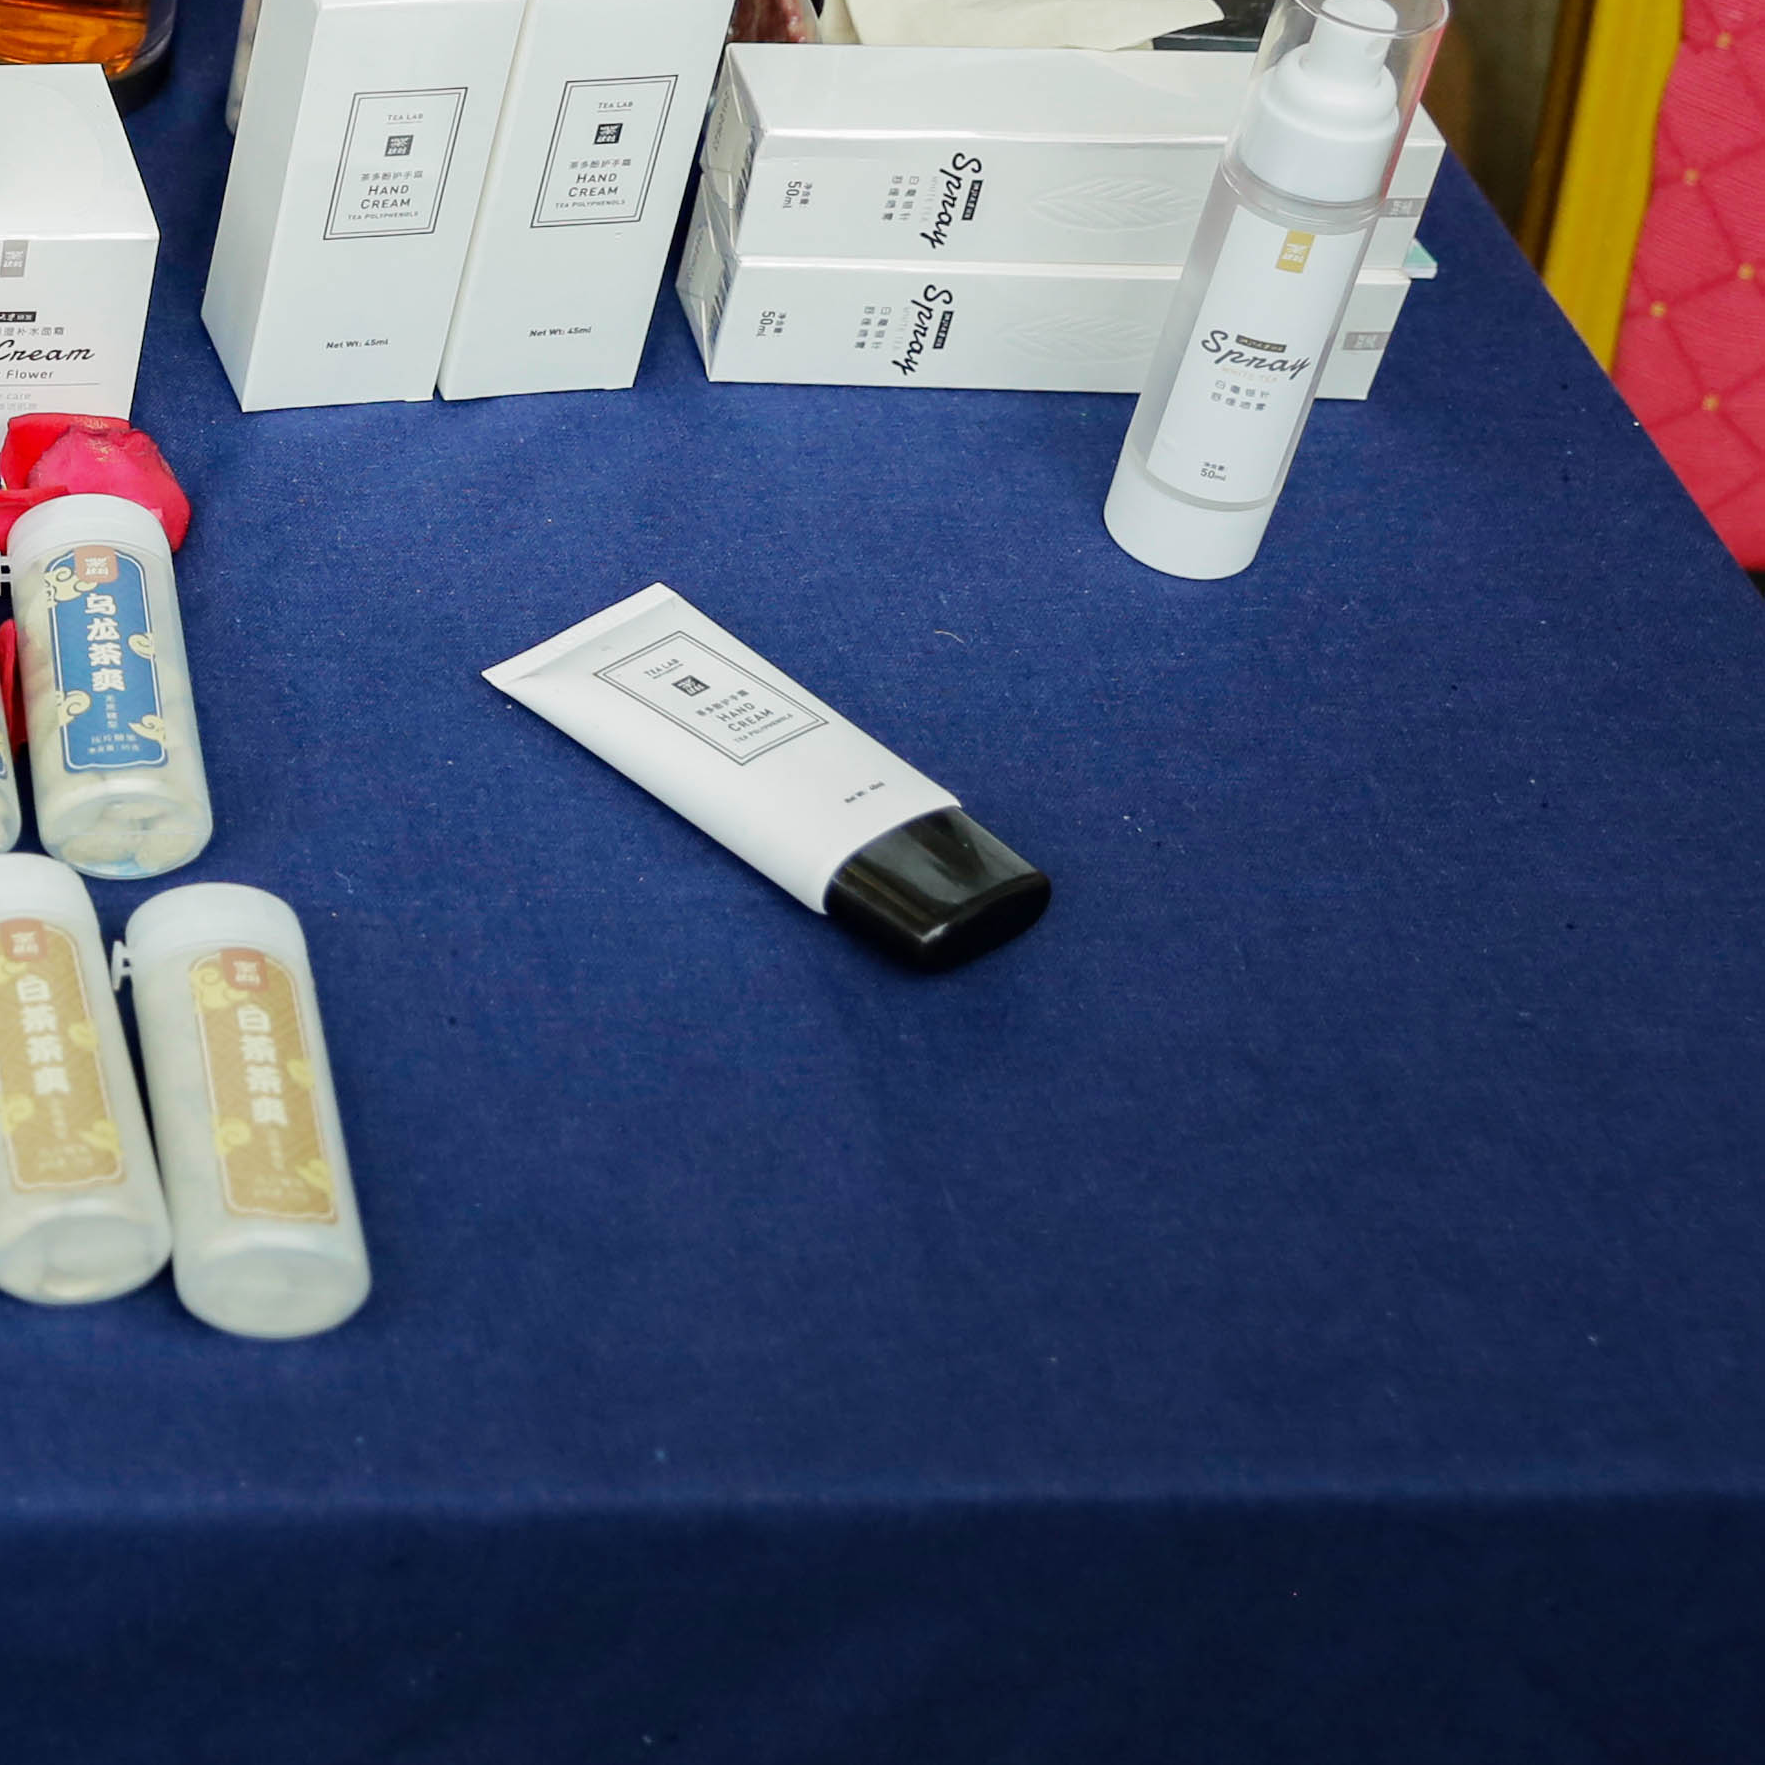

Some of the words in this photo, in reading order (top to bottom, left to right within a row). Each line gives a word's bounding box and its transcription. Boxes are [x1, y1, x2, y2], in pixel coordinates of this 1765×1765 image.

[576, 172, 617, 184] HAND
[368, 184, 409, 196] HAND
[568, 186, 618, 198] CREAM
[783, 180, 802, 209] 50ml
[919, 152, 983, 249] Spray
[361, 198, 410, 210] CREAM
[756, 310, 776, 337] 50ml
[892, 284, 953, 376] Spray
[1201, 330, 1310, 380] Spray
[7, 369, 54, 379] Flower
[1200, 467, 1226, 481] 50ml
[85, 593, 125, 692] 乌龙茶爽
[716, 702, 755, 721] HAND
[728, 709, 773, 732] CREAM
